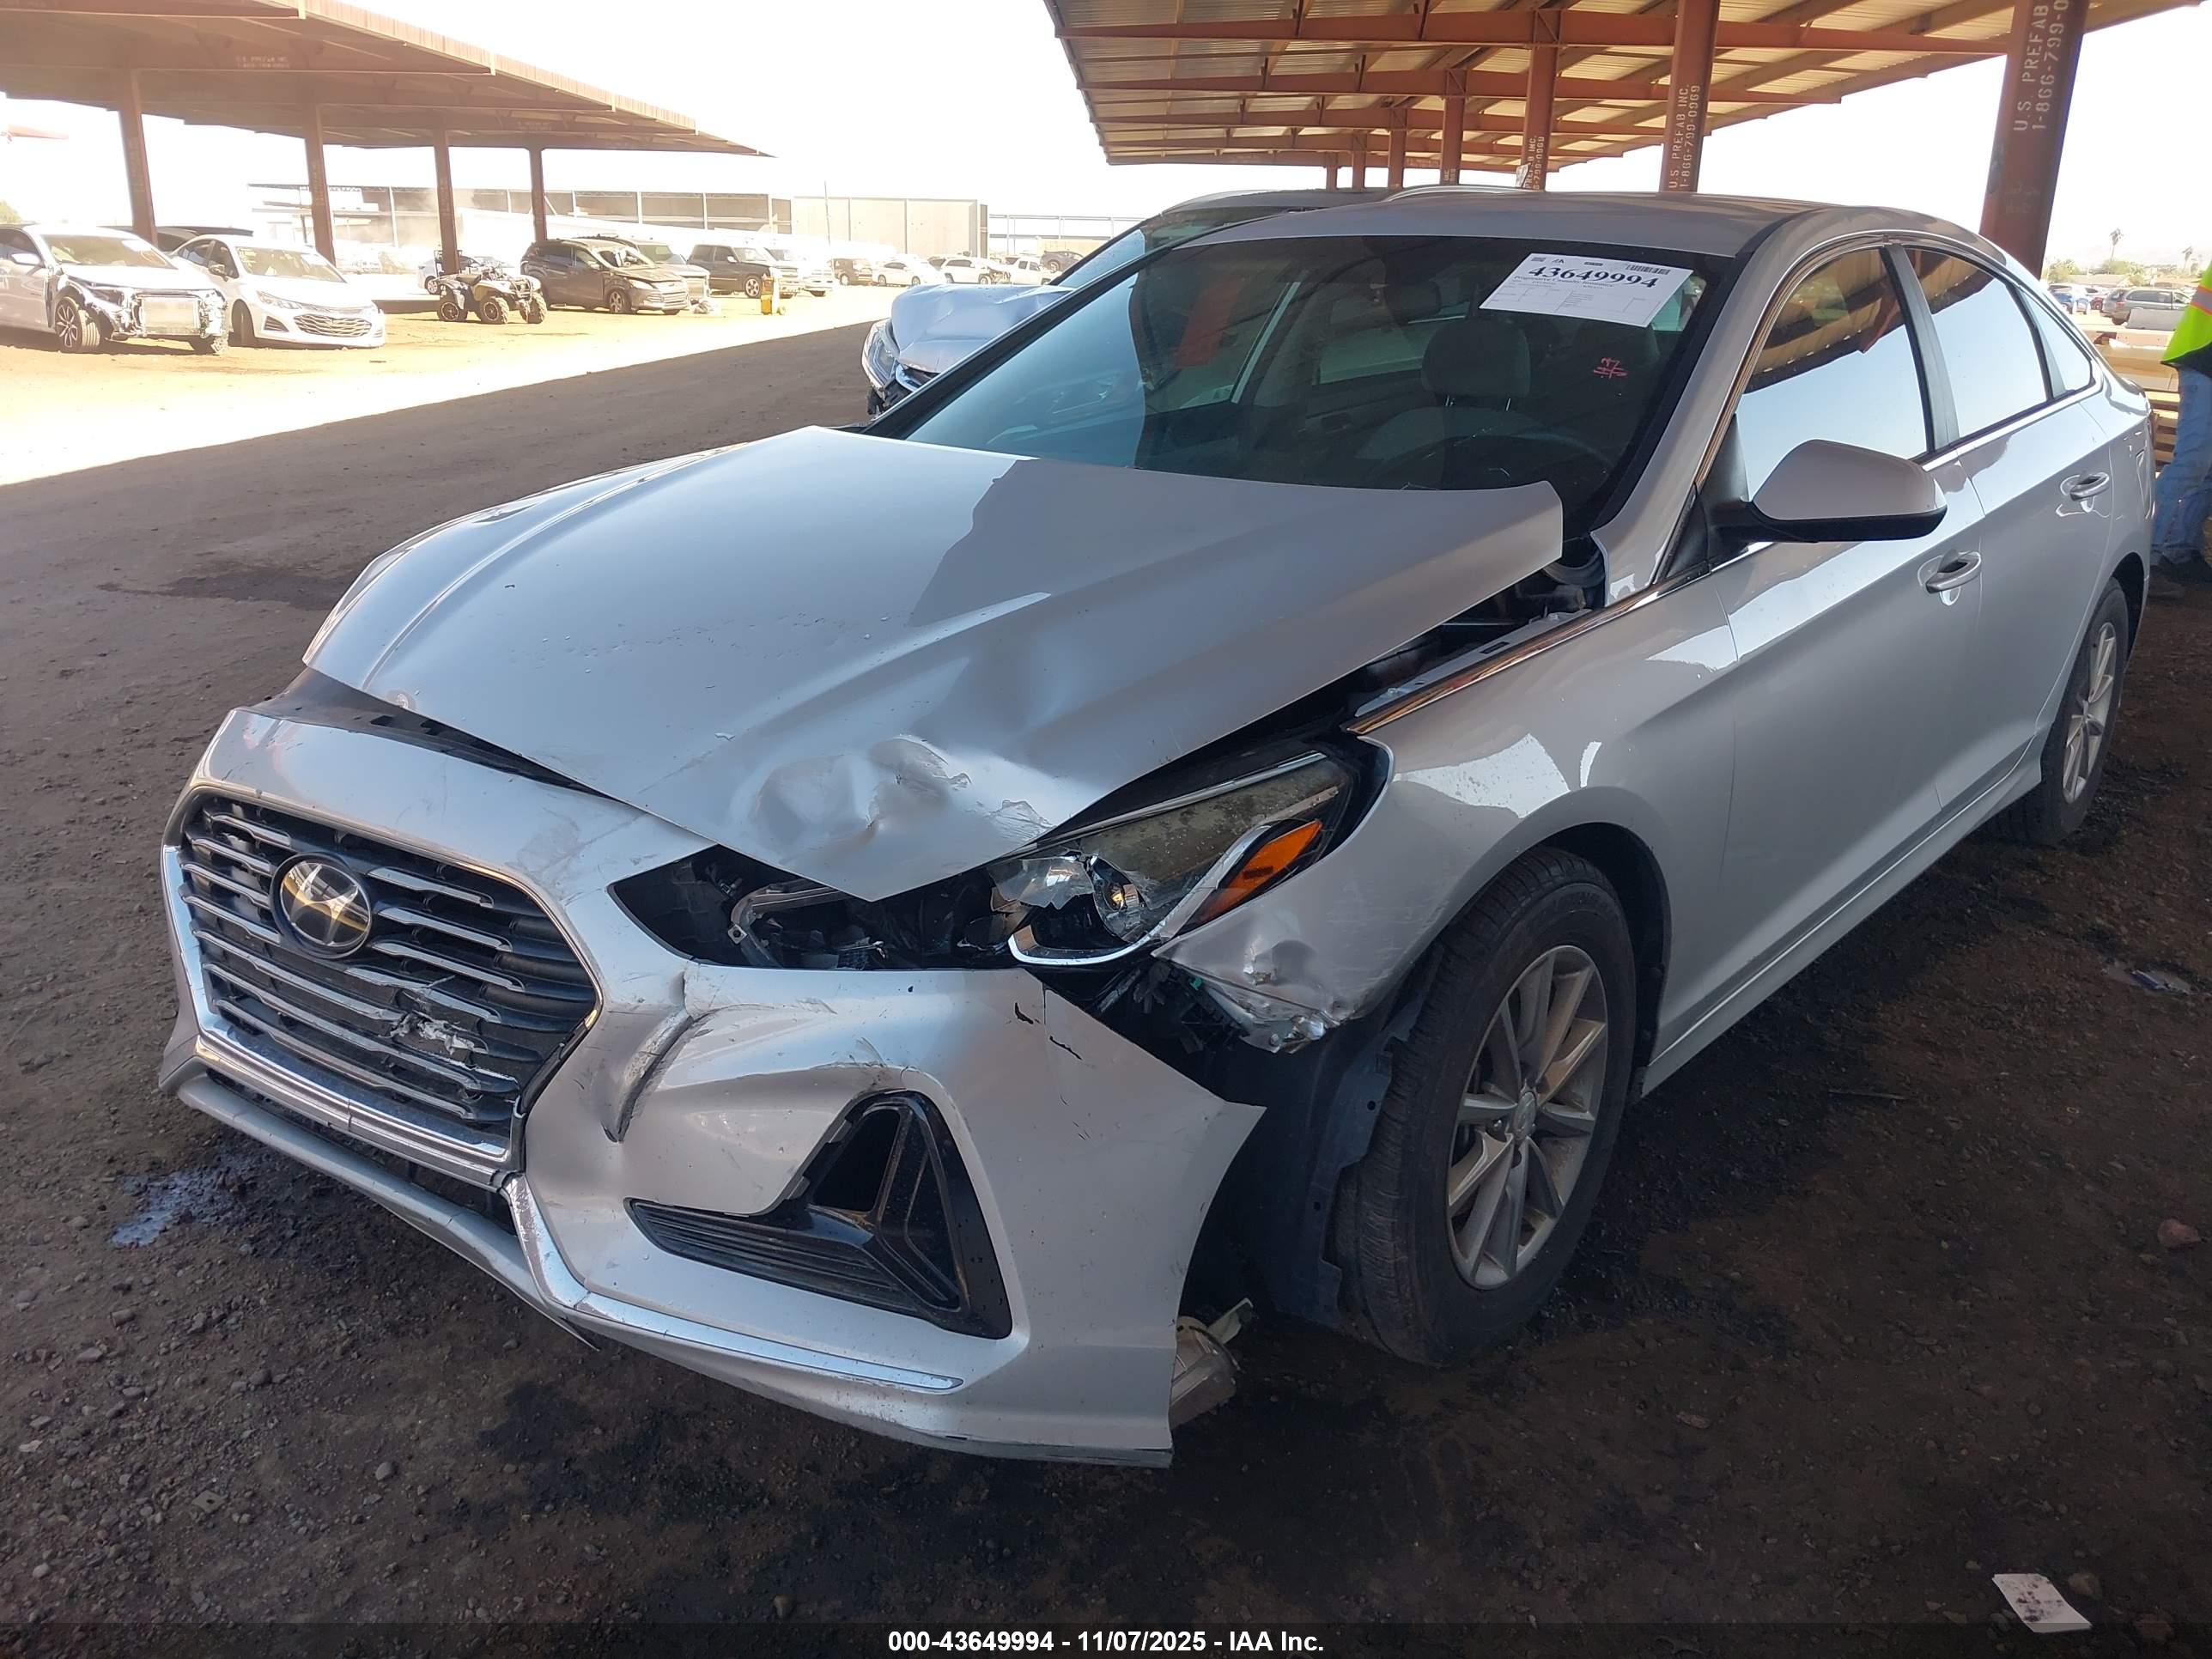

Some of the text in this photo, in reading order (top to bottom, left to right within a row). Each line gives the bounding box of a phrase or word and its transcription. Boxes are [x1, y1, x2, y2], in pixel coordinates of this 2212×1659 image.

[2021, 5, 2049, 82] PREFAB
[1678, 84, 1689, 107] INC.
[1672, 113, 1686, 160] PREFAB
[1680, 85, 1700, 187] 1-866-799-0969
[1528, 265, 1659, 289] 43649994
